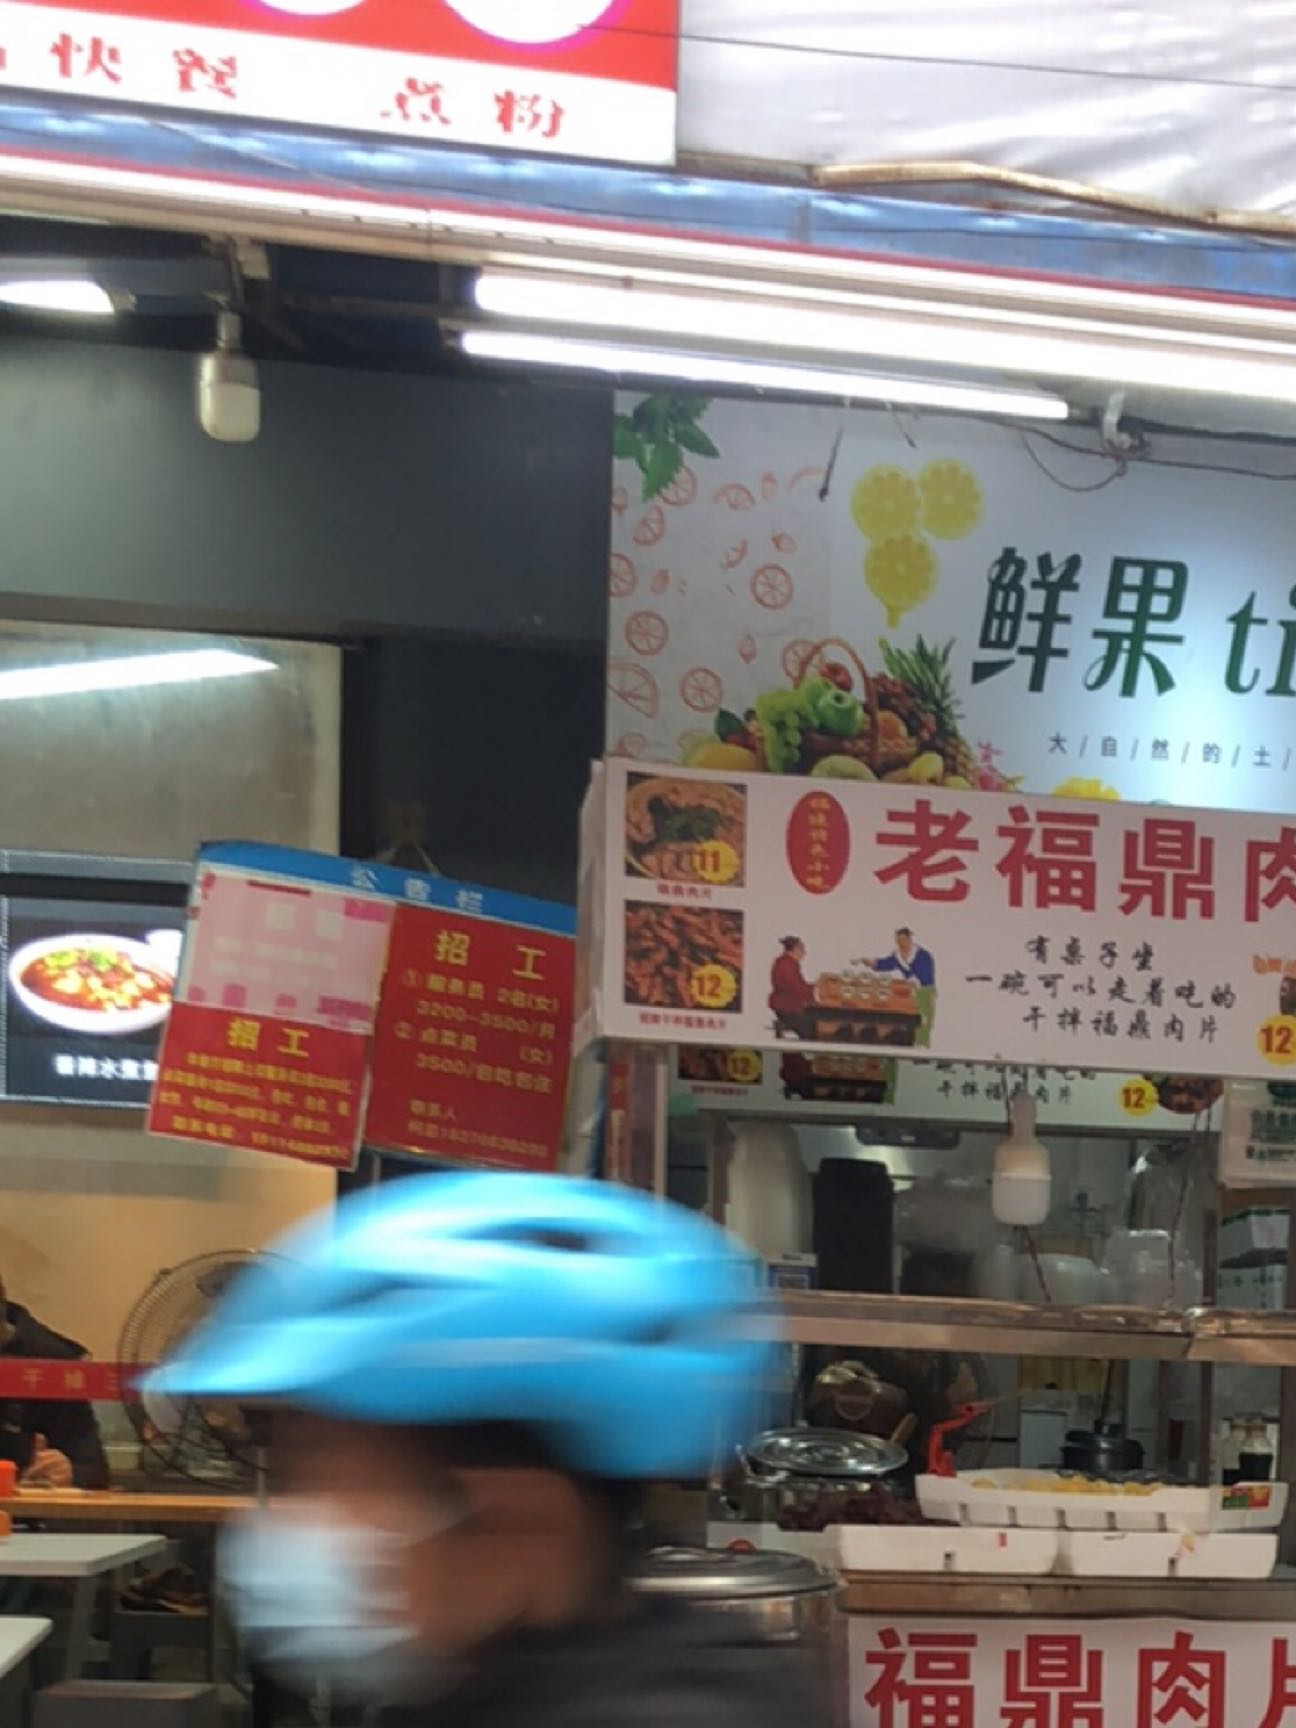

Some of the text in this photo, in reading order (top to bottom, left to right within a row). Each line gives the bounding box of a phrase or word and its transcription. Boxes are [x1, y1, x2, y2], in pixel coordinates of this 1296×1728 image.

[971, 546, 1189, 698] 鲜果
[434, 928, 547, 981] 招工
[1025, 935, 1154, 971] 有桌子坐
[697, 975, 721, 998] 12
[965, 969, 1236, 1009] 一碗可以走着吃的
[228, 1018, 310, 1058] 招工
[1022, 1005, 1218, 1043] 干拌福鼎肉片
[1260, 1026, 1293, 1054] 12
[1122, 1087, 1146, 1108] 12
